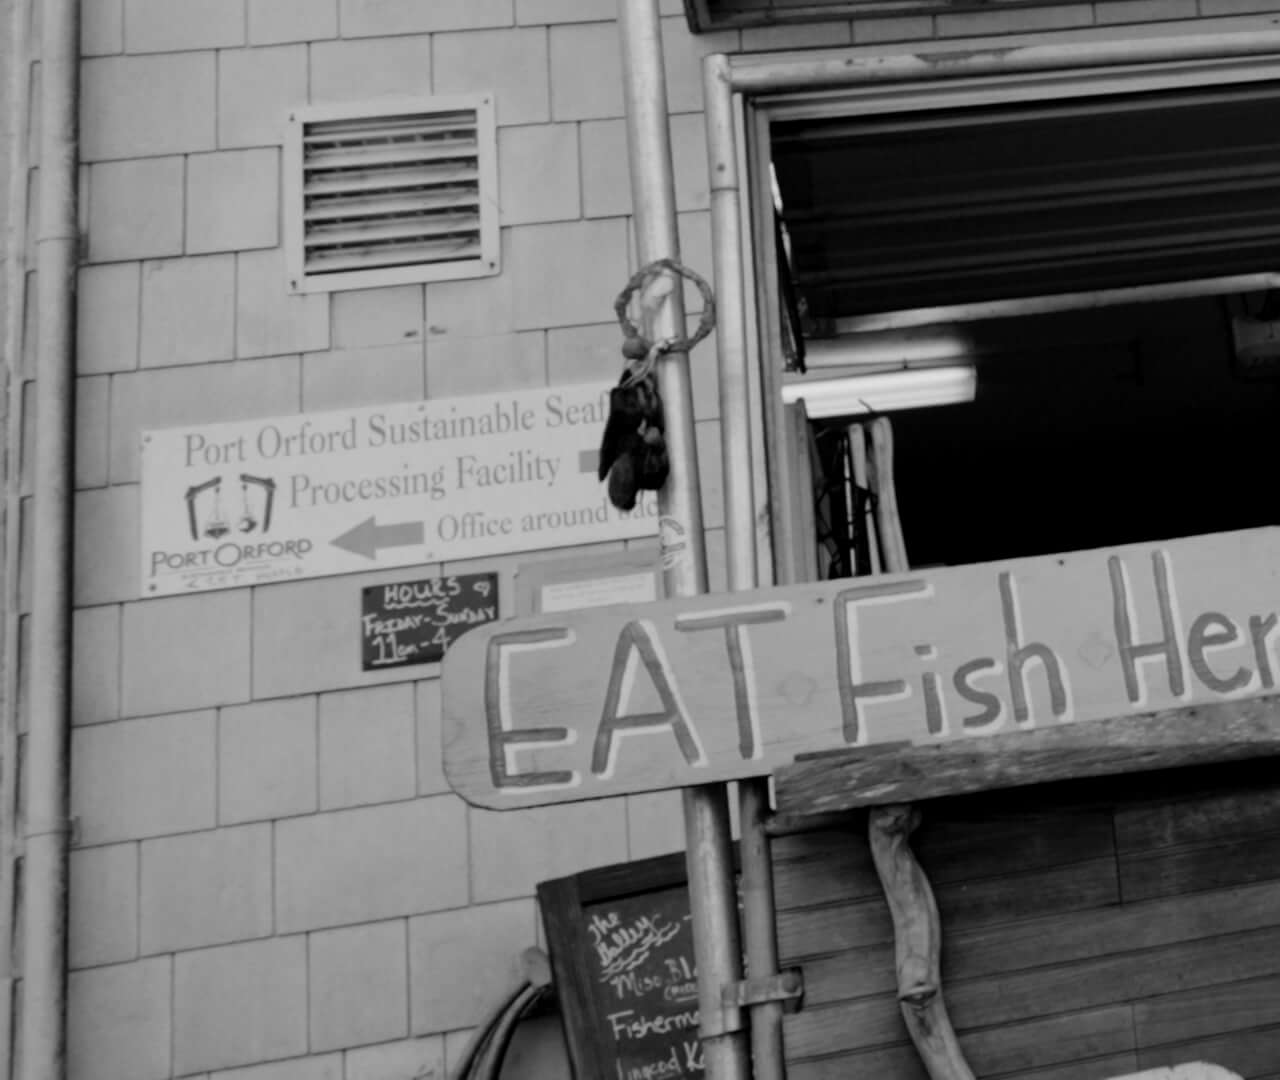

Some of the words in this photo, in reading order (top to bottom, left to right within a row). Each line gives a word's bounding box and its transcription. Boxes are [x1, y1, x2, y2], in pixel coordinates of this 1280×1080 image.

[184, 433, 246, 468] Port
[257, 420, 357, 460] Orford
[369, 399, 535, 449] Sustainable
[544, 389, 611, 431] Seaf
[289, 463, 446, 508] Processing
[457, 448, 560, 492] Facility
[437, 511, 510, 542] Office
[521, 497, 608, 532] around
[151, 549, 210, 578] PORT
[214, 538, 312, 567] ORFORD
[384, 576, 461, 603] HOURS
[484, 602, 786, 790] EAT
[834, 572, 1068, 744] Fish
